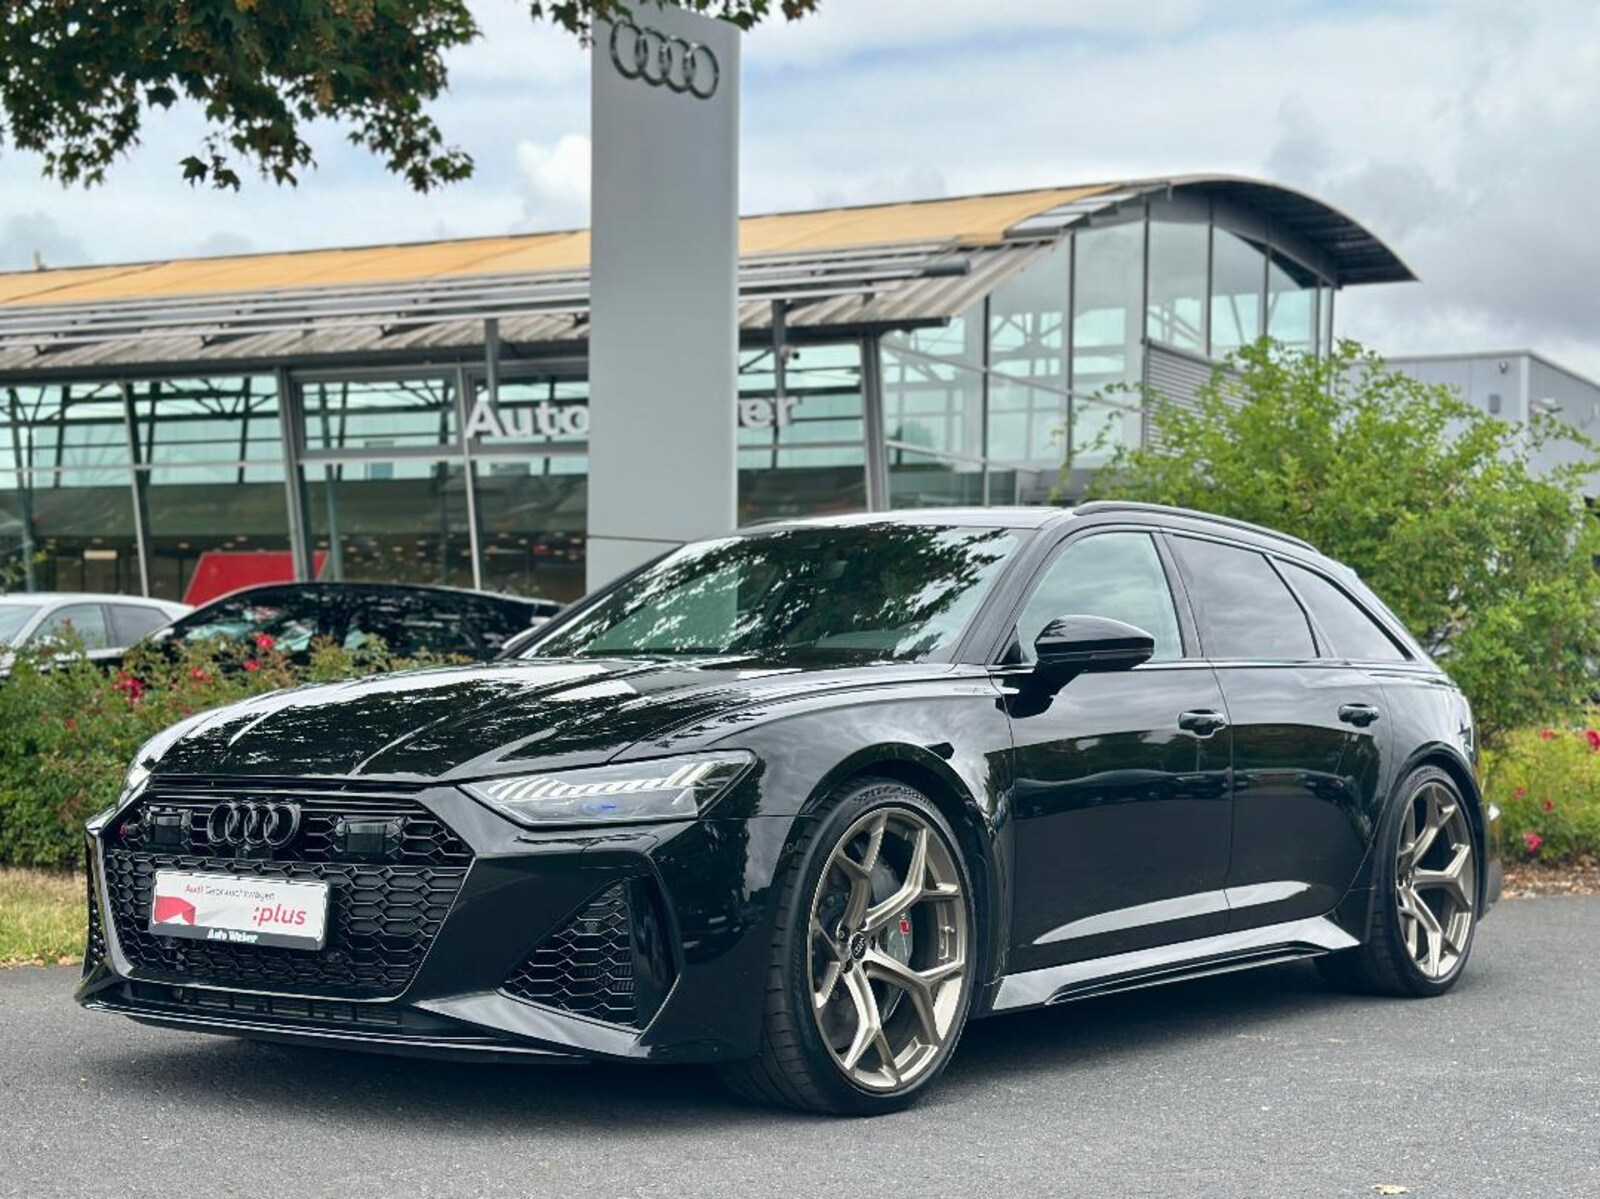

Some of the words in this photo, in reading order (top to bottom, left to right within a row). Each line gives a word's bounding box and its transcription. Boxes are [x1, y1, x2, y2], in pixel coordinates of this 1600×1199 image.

[464, 402, 589, 439] Auto
[185, 884, 204, 895] Audi
[253, 903, 307, 927] :plus
[207, 929, 227, 941] Auto
